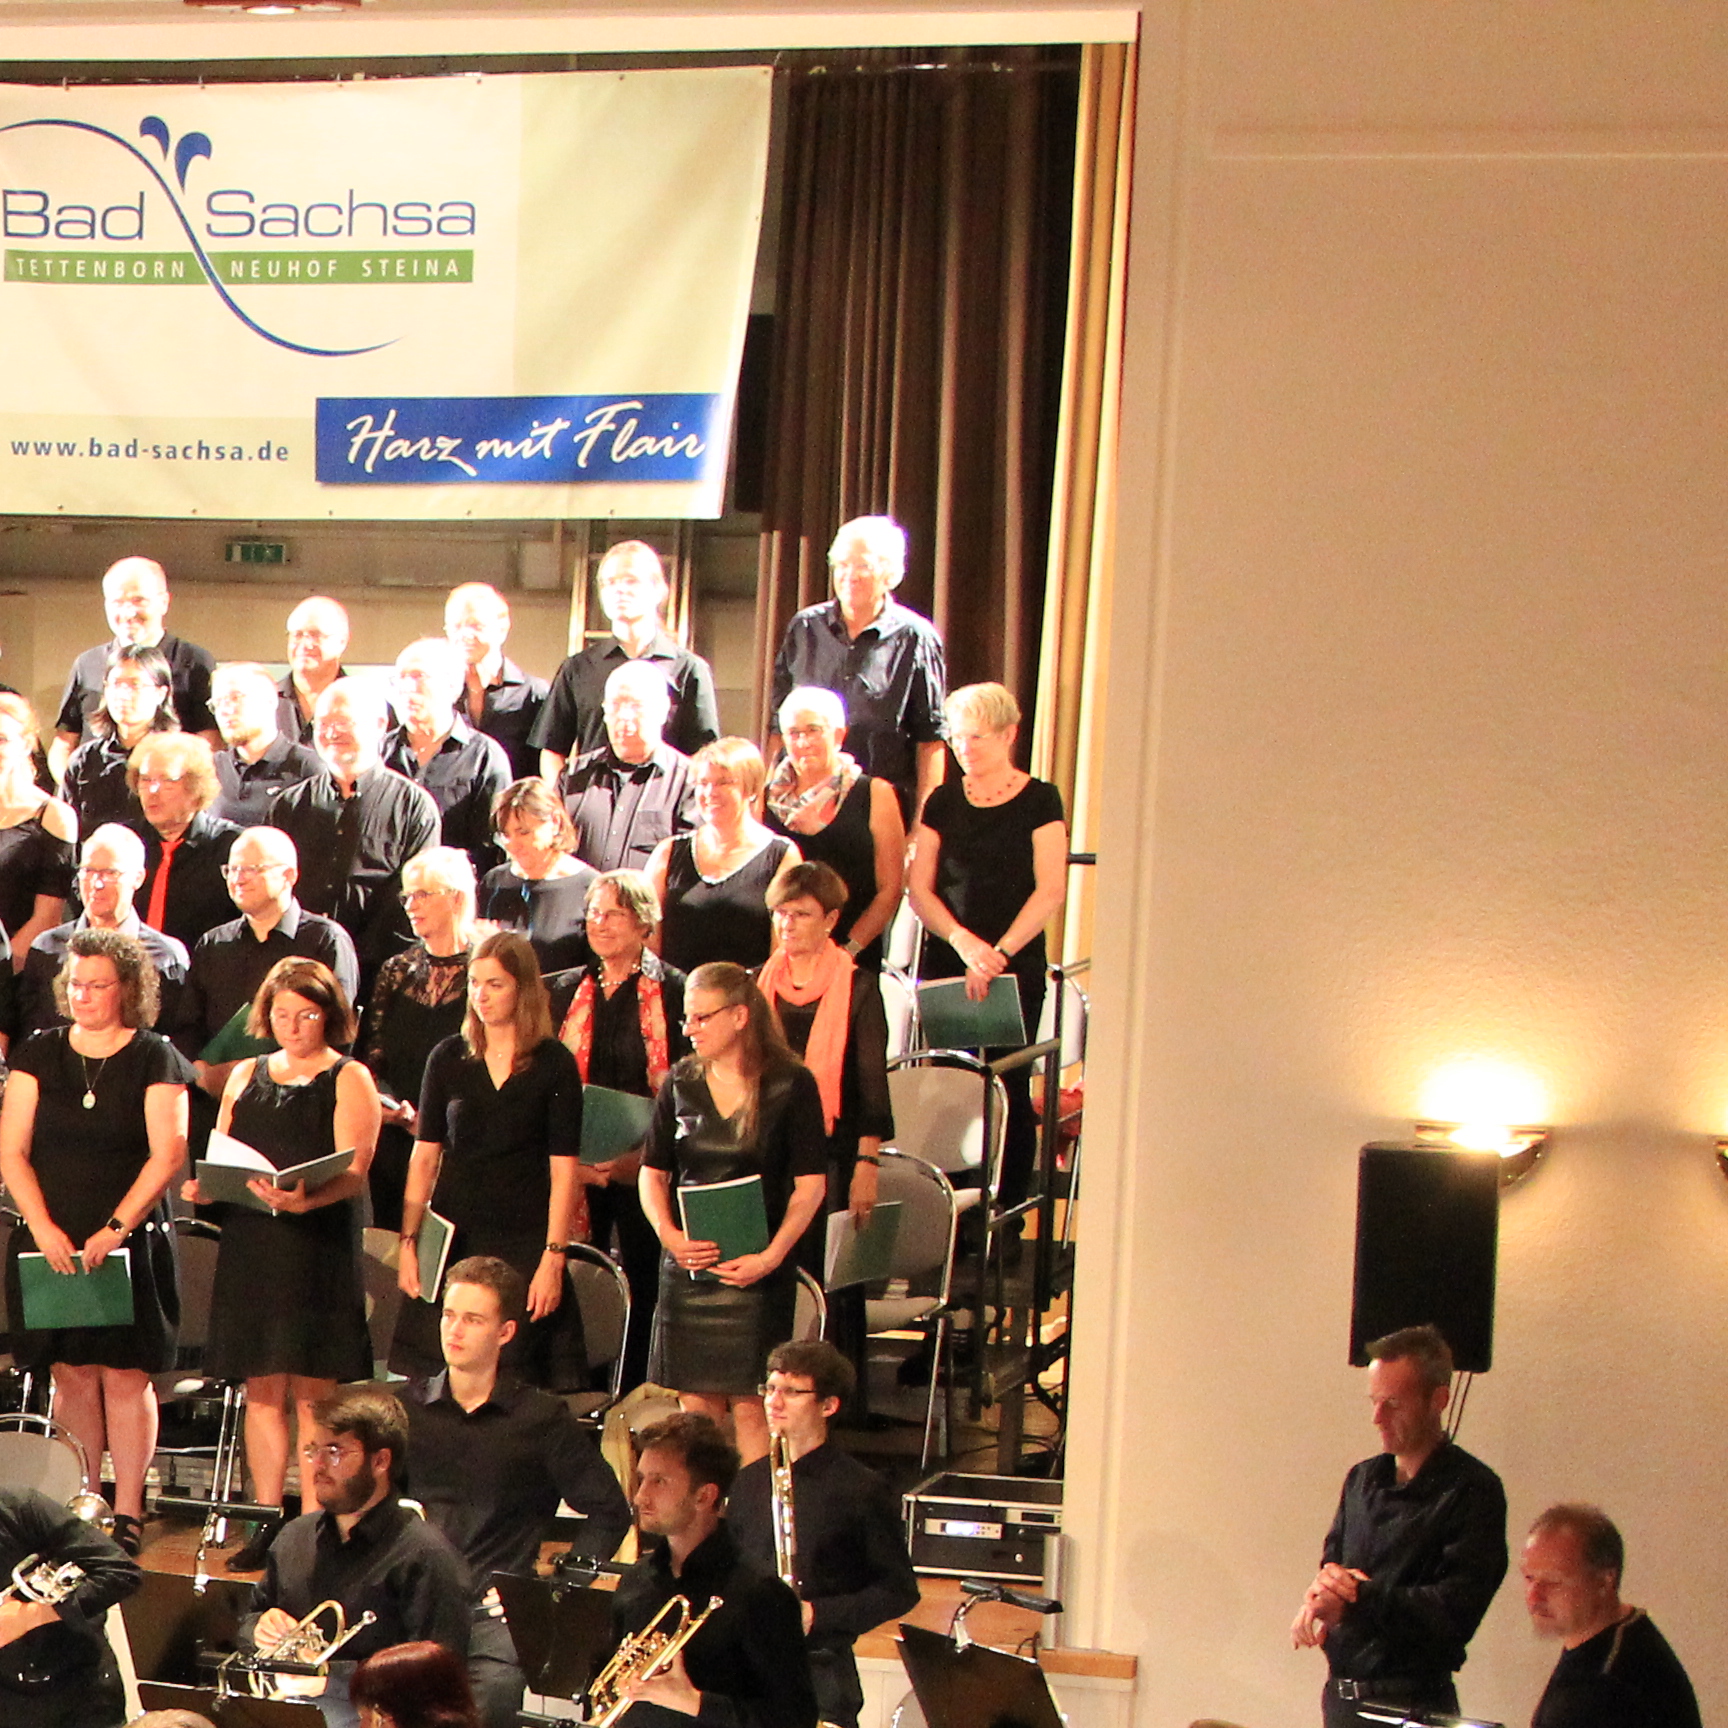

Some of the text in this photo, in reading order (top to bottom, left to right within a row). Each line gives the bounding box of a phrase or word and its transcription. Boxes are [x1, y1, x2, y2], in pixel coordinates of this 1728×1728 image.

[2, 188, 477, 240] Bad Sachsa
[15, 257, 460, 278] TETTENBORN NEUHOF STEINA
[10, 437, 290, 462] www.bad-sachsa.de
[346, 400, 707, 477] Harz mit Flair
